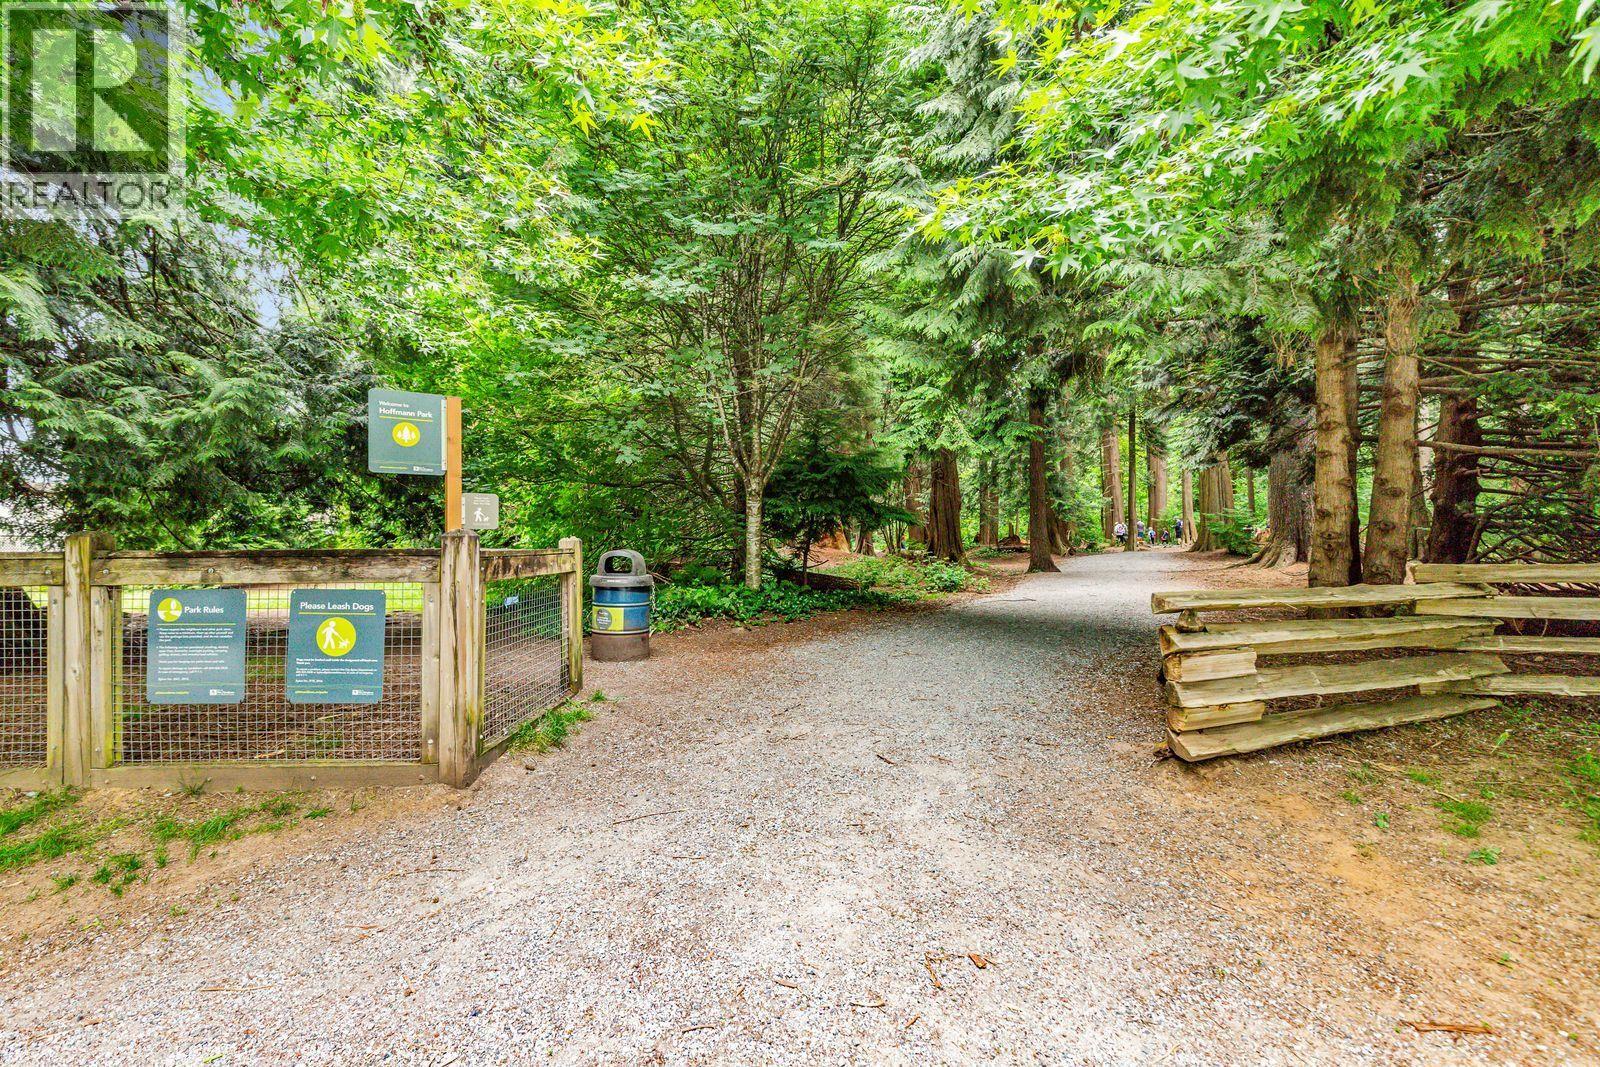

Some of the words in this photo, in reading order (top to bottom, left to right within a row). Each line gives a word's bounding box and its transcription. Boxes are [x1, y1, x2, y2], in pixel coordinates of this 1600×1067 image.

[379, 407, 416, 417] Hoffmann
[417, 410, 433, 418] Park
[184, 605, 201, 613] Park
[203, 605, 224, 614] Rules
[300, 602, 326, 610] Please
[327, 602, 350, 610] Leash
[352, 602, 374, 612] Dogs
